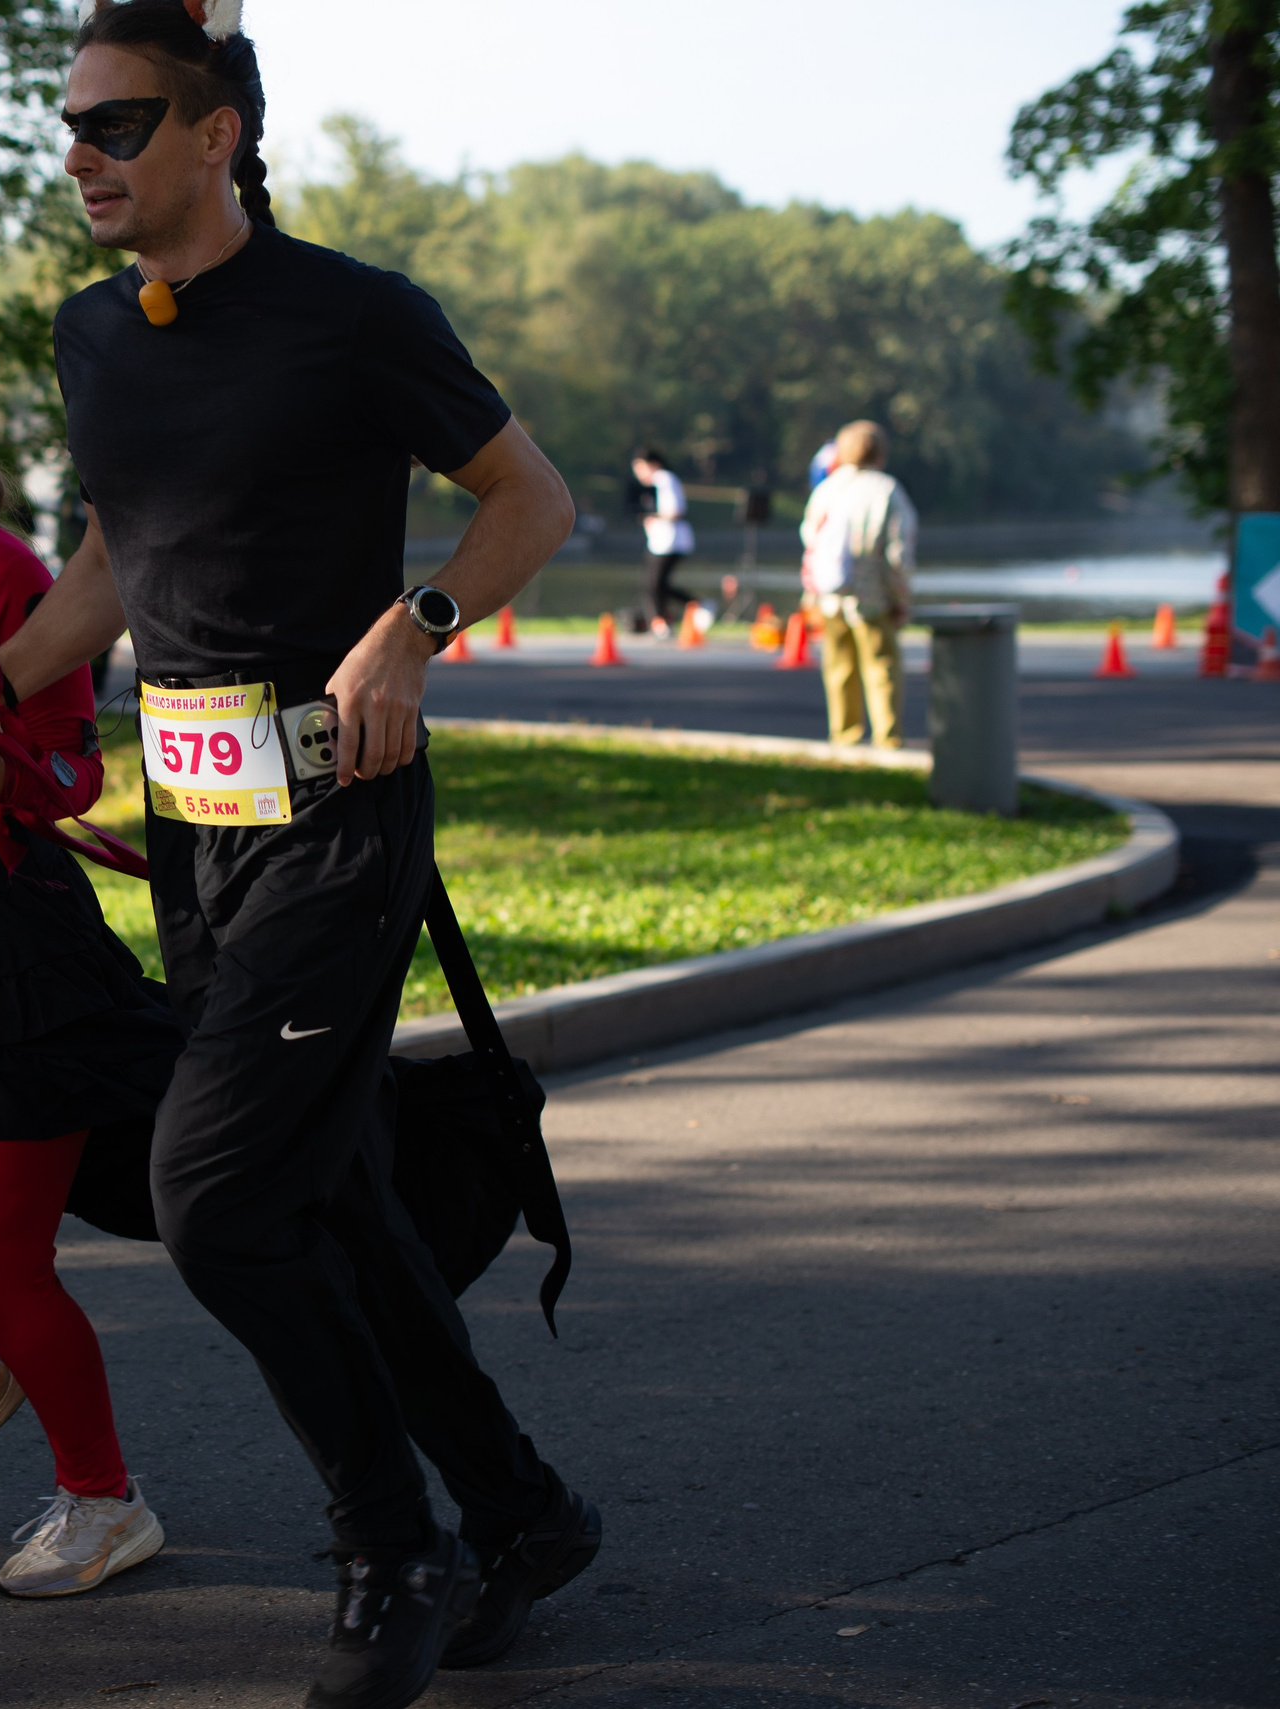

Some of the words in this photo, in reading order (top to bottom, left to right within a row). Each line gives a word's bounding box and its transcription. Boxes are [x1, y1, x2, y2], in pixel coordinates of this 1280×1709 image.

[145, 693, 205, 710] ИНКЛЮЗИВНЫЙ
[210, 694, 247, 709] ЗАБЕГ
[158, 729, 243, 775] 579
[185, 796, 211, 817] 5,5
